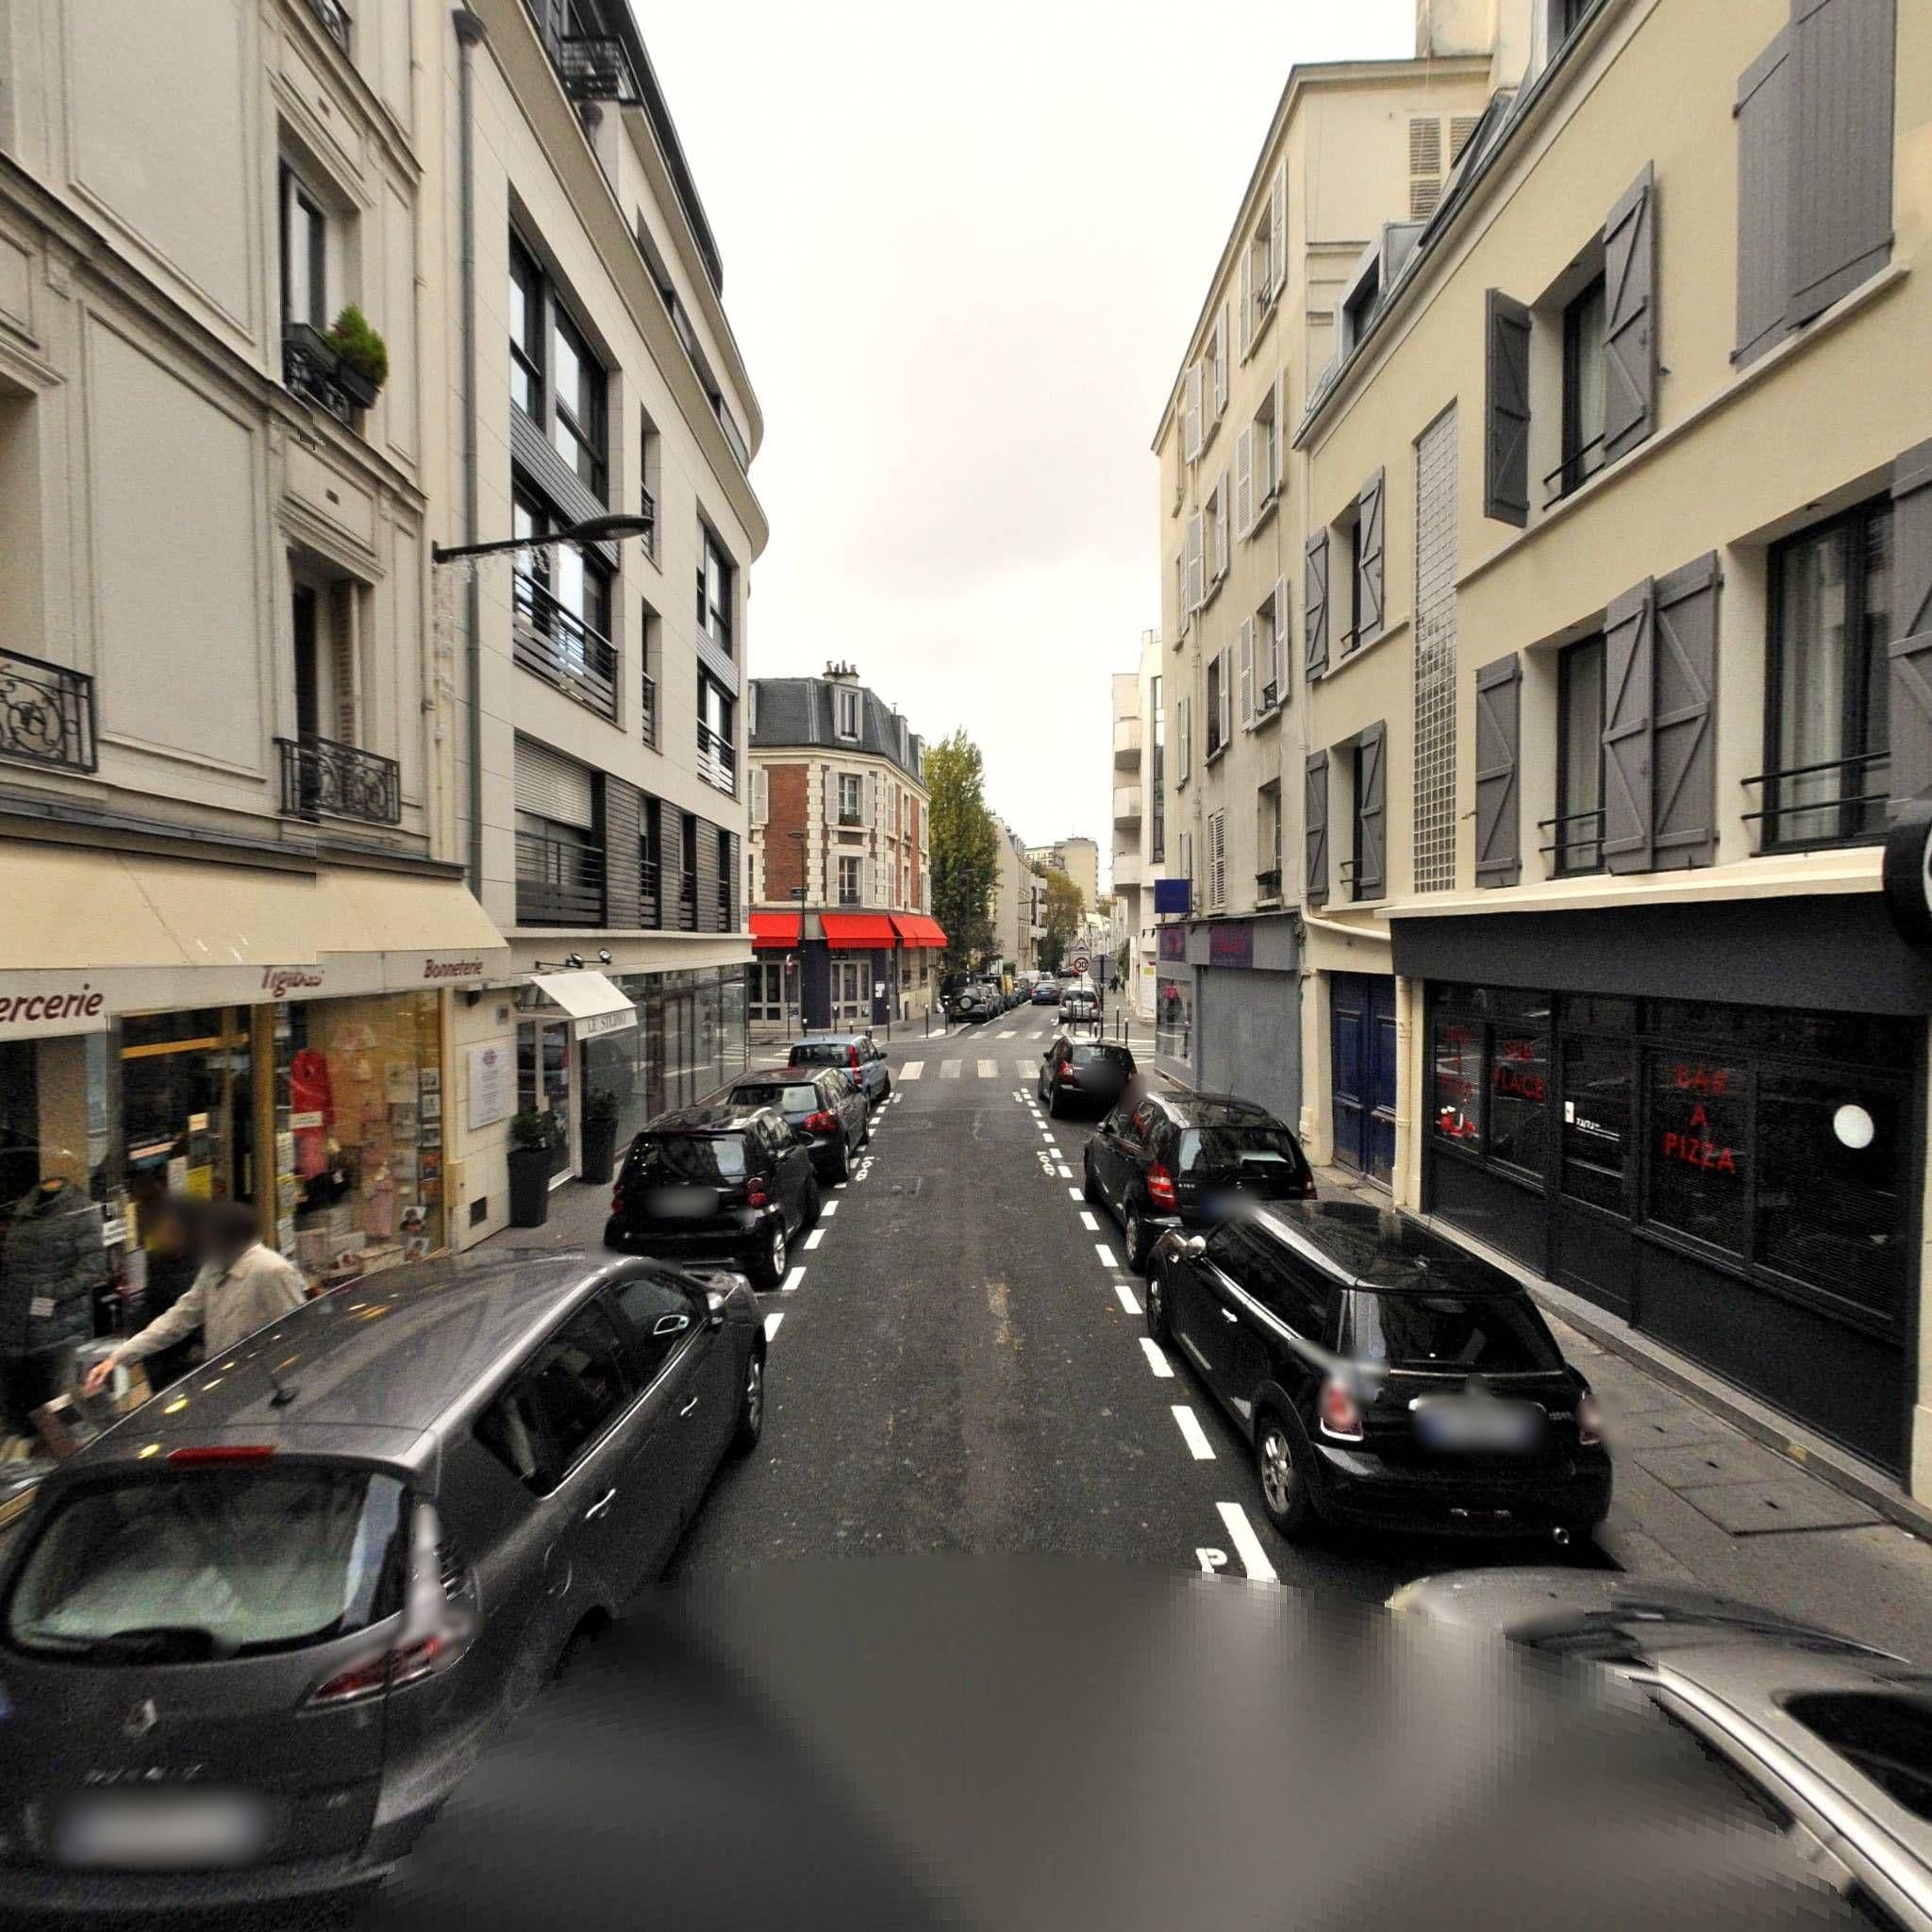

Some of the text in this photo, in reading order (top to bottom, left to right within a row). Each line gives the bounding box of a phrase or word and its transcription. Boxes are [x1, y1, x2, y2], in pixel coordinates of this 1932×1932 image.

[424, 956, 483, 979] Bonneterie
[1077, 960, 1087, 969] 30
[1662, 1131, 1738, 1174] PIZZA
